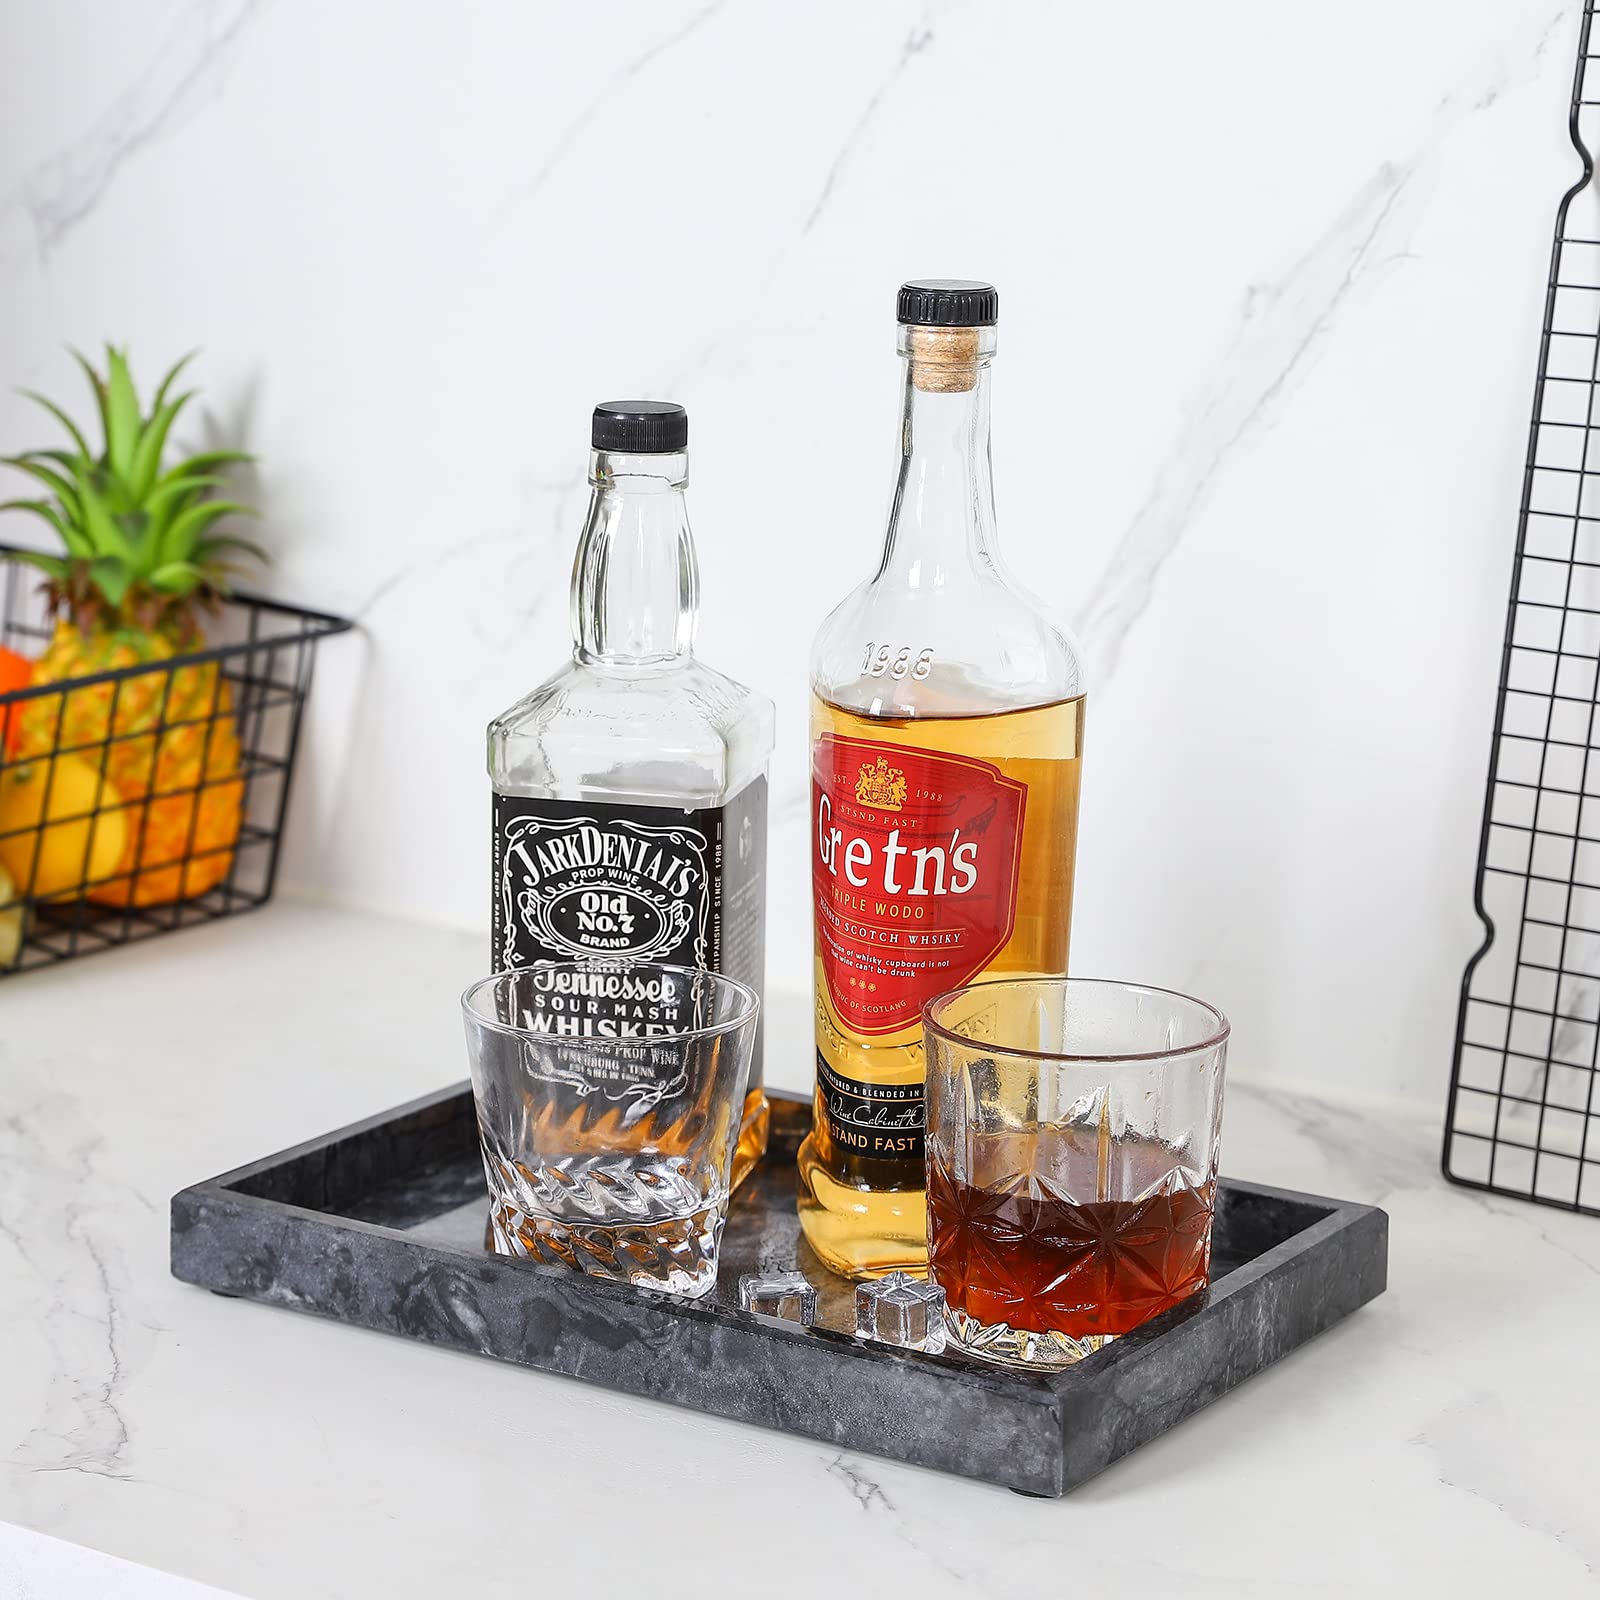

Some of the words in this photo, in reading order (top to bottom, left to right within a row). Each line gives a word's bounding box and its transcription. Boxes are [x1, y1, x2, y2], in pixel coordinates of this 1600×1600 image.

[916, 789, 943, 801] 1988
[839, 805, 876, 822] STSND
[883, 817, 918, 828] FAST
[819, 793, 978, 896] Gretn's
[571, 867, 605, 881] PROP
[608, 868, 640, 885] WINE
[580, 892, 628, 914] Old
[831, 884, 866, 912] TRIPLE
[875, 902, 924, 919] WODO
[576, 912, 635, 934] No.7
[844, 922, 899, 943] SCOTCH
[908, 933, 961, 945] WHSIKY
[580, 933, 630, 948] BRAND
[840, 955, 853, 967] wine
[855, 961, 874, 973] can't
[877, 966, 887, 975] be
[890, 967, 916, 977] drunk
[846, 949, 854, 957] of
[855, 952, 882, 966] whisky
[885, 959, 926, 971] cupboard
[928, 960, 935, 968] is
[533, 959, 676, 1003] Tennessee
[535, 994, 598, 1014] SOUR
[614, 1004, 678, 1021] MASH
[850, 1001, 859, 1009] OF
[853, 1086, 858, 1094] &
[862, 1088, 905, 1098] BLENDED
[831, 1123, 868, 1148] STAND
[875, 1137, 916, 1151] FAST
